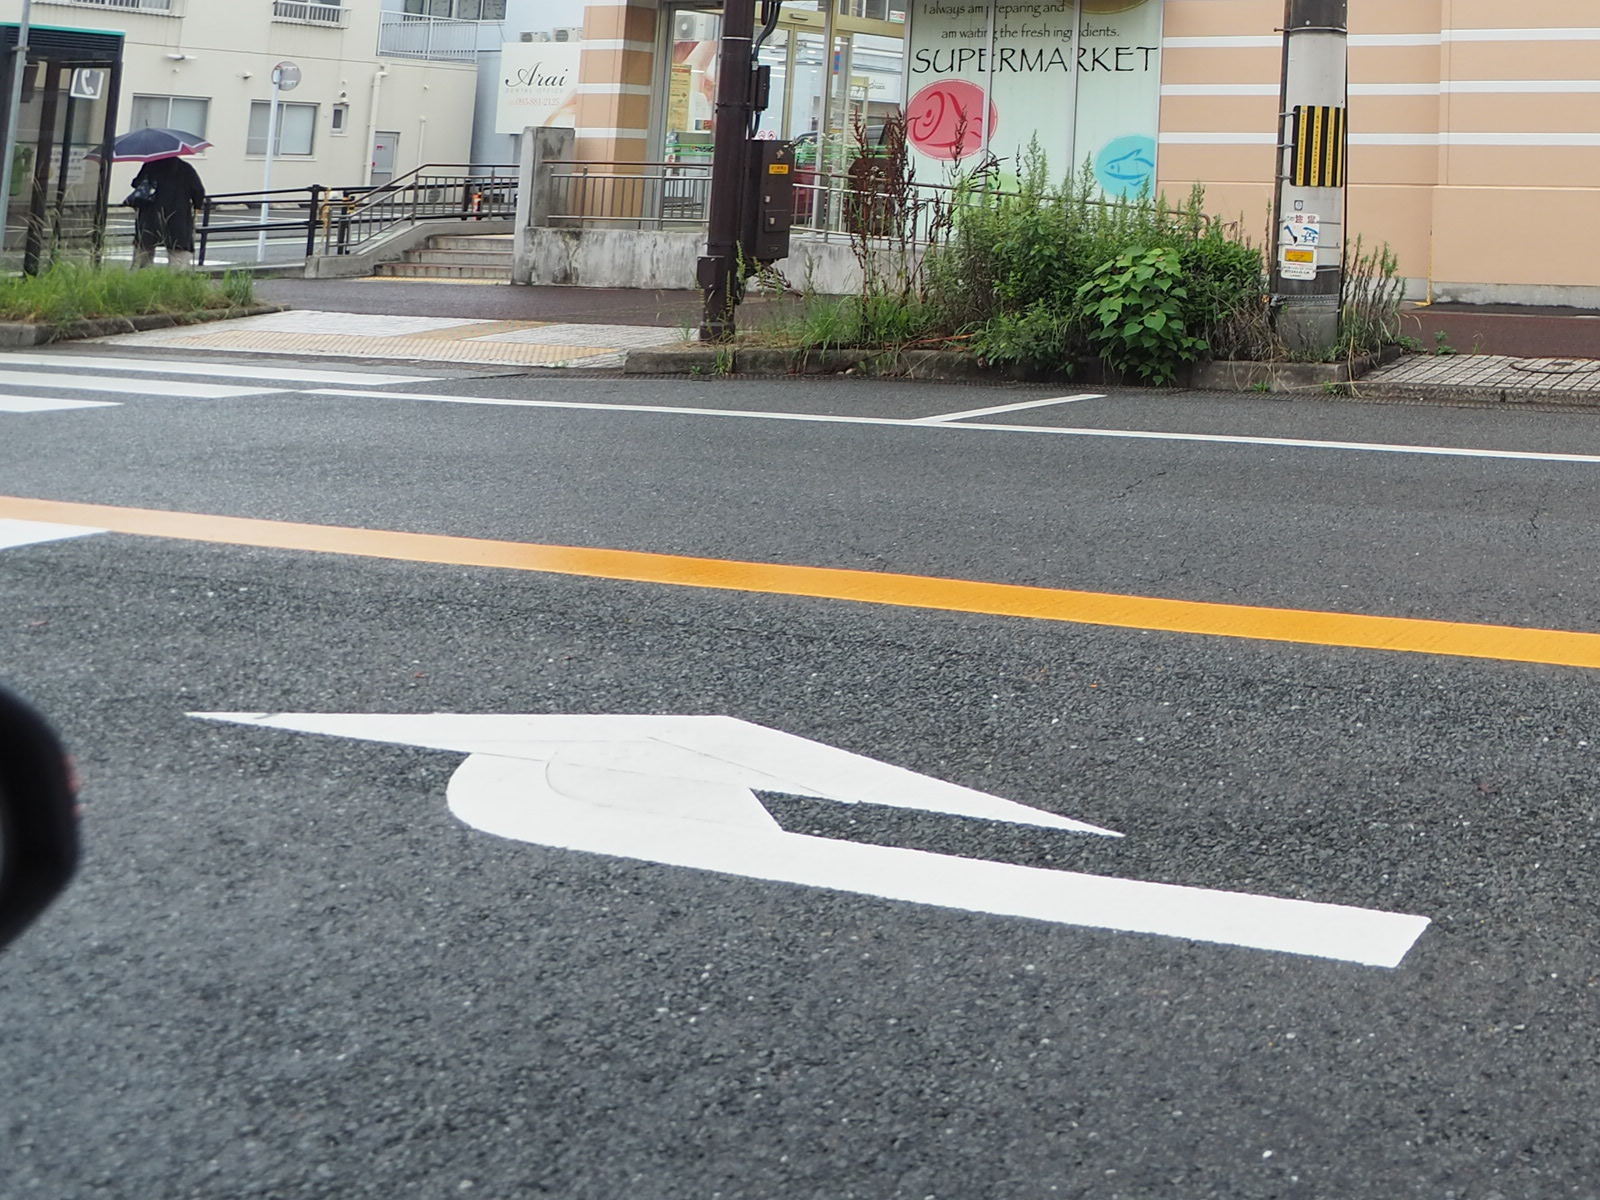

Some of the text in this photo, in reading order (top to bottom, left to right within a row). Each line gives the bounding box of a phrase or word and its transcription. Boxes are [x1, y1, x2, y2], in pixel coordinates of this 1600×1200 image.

[929, 1, 966, 19] always
[967, 5, 984, 14] am
[941, 29, 957, 39] am
[999, 23, 1019, 38] the
[1020, 22, 1051, 38] fresh
[1053, 21, 1121, 43] ingrdients.
[911, 46, 1159, 74] SUPERMARKET
[504, 61, 569, 88] Arai
